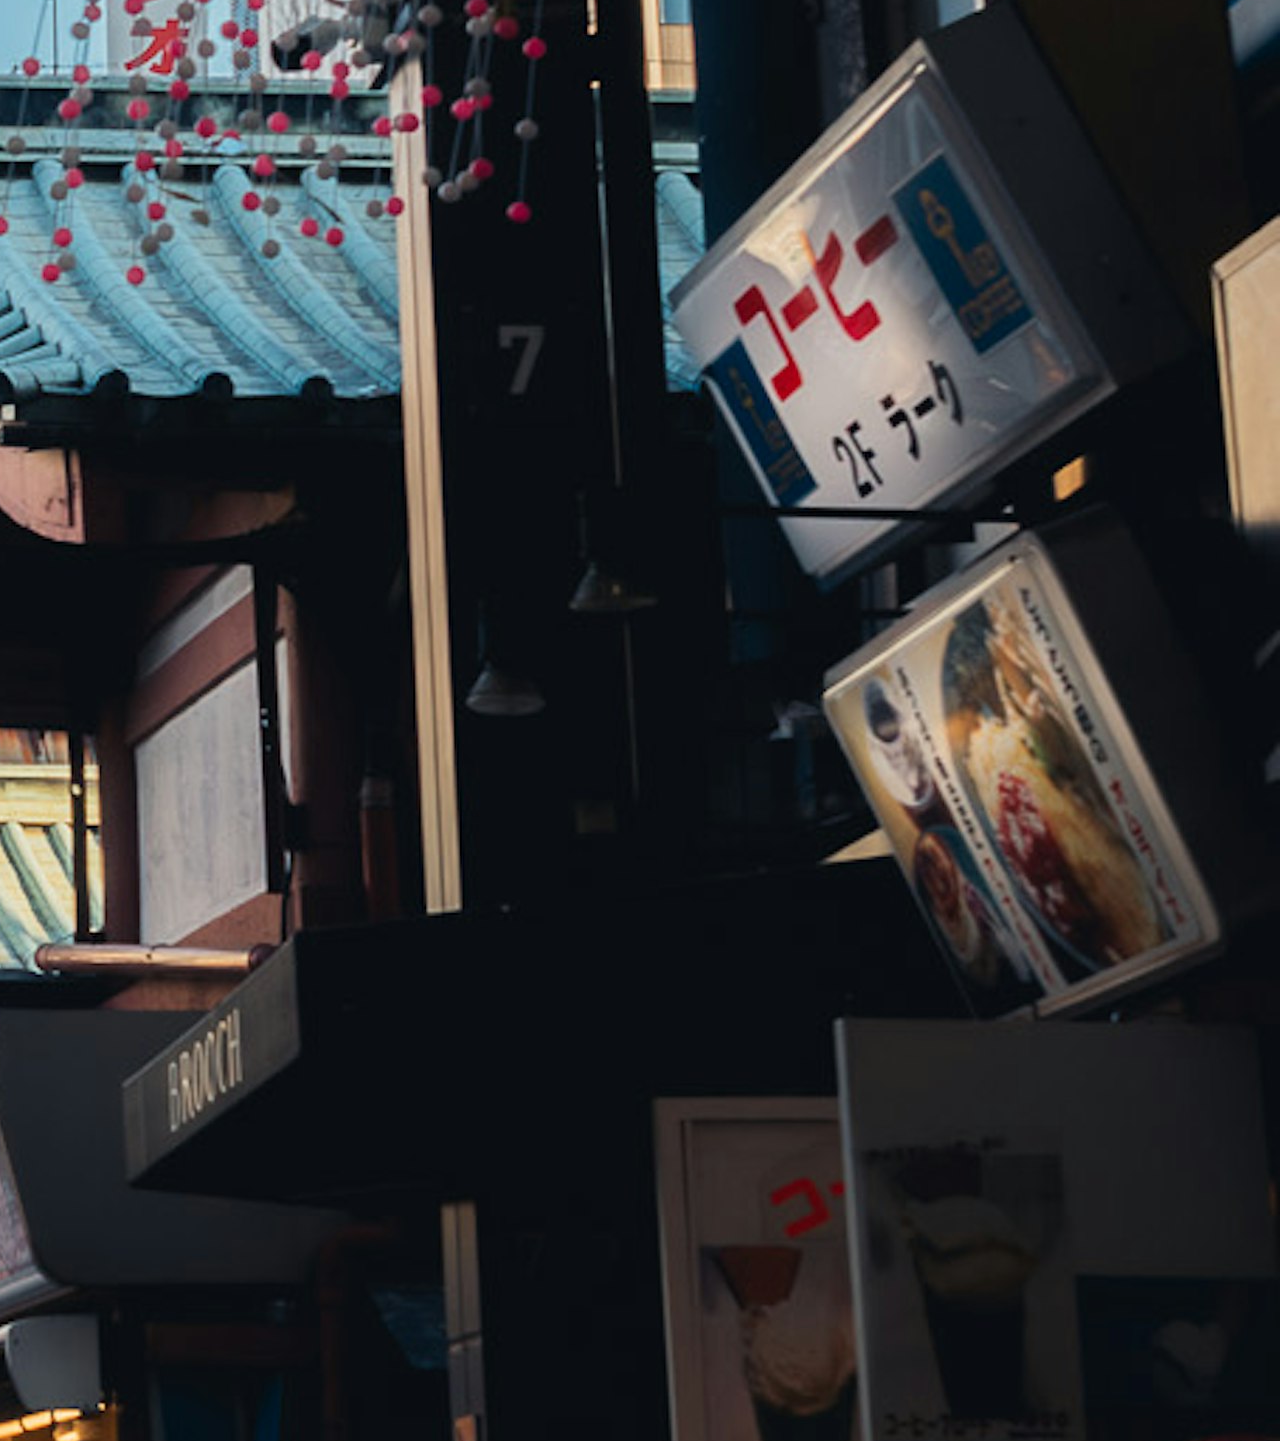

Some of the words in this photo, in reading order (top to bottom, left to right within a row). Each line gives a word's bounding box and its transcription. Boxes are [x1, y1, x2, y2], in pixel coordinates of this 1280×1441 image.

[498, 326, 548, 395] 7
[734, 215, 900, 402] コーヒー
[833, 422, 883, 498] 2F
[880, 360, 964, 463] ラーク
[167, 1007, 244, 1133] BROOCH
[772, 1176, 844, 1238] コ
